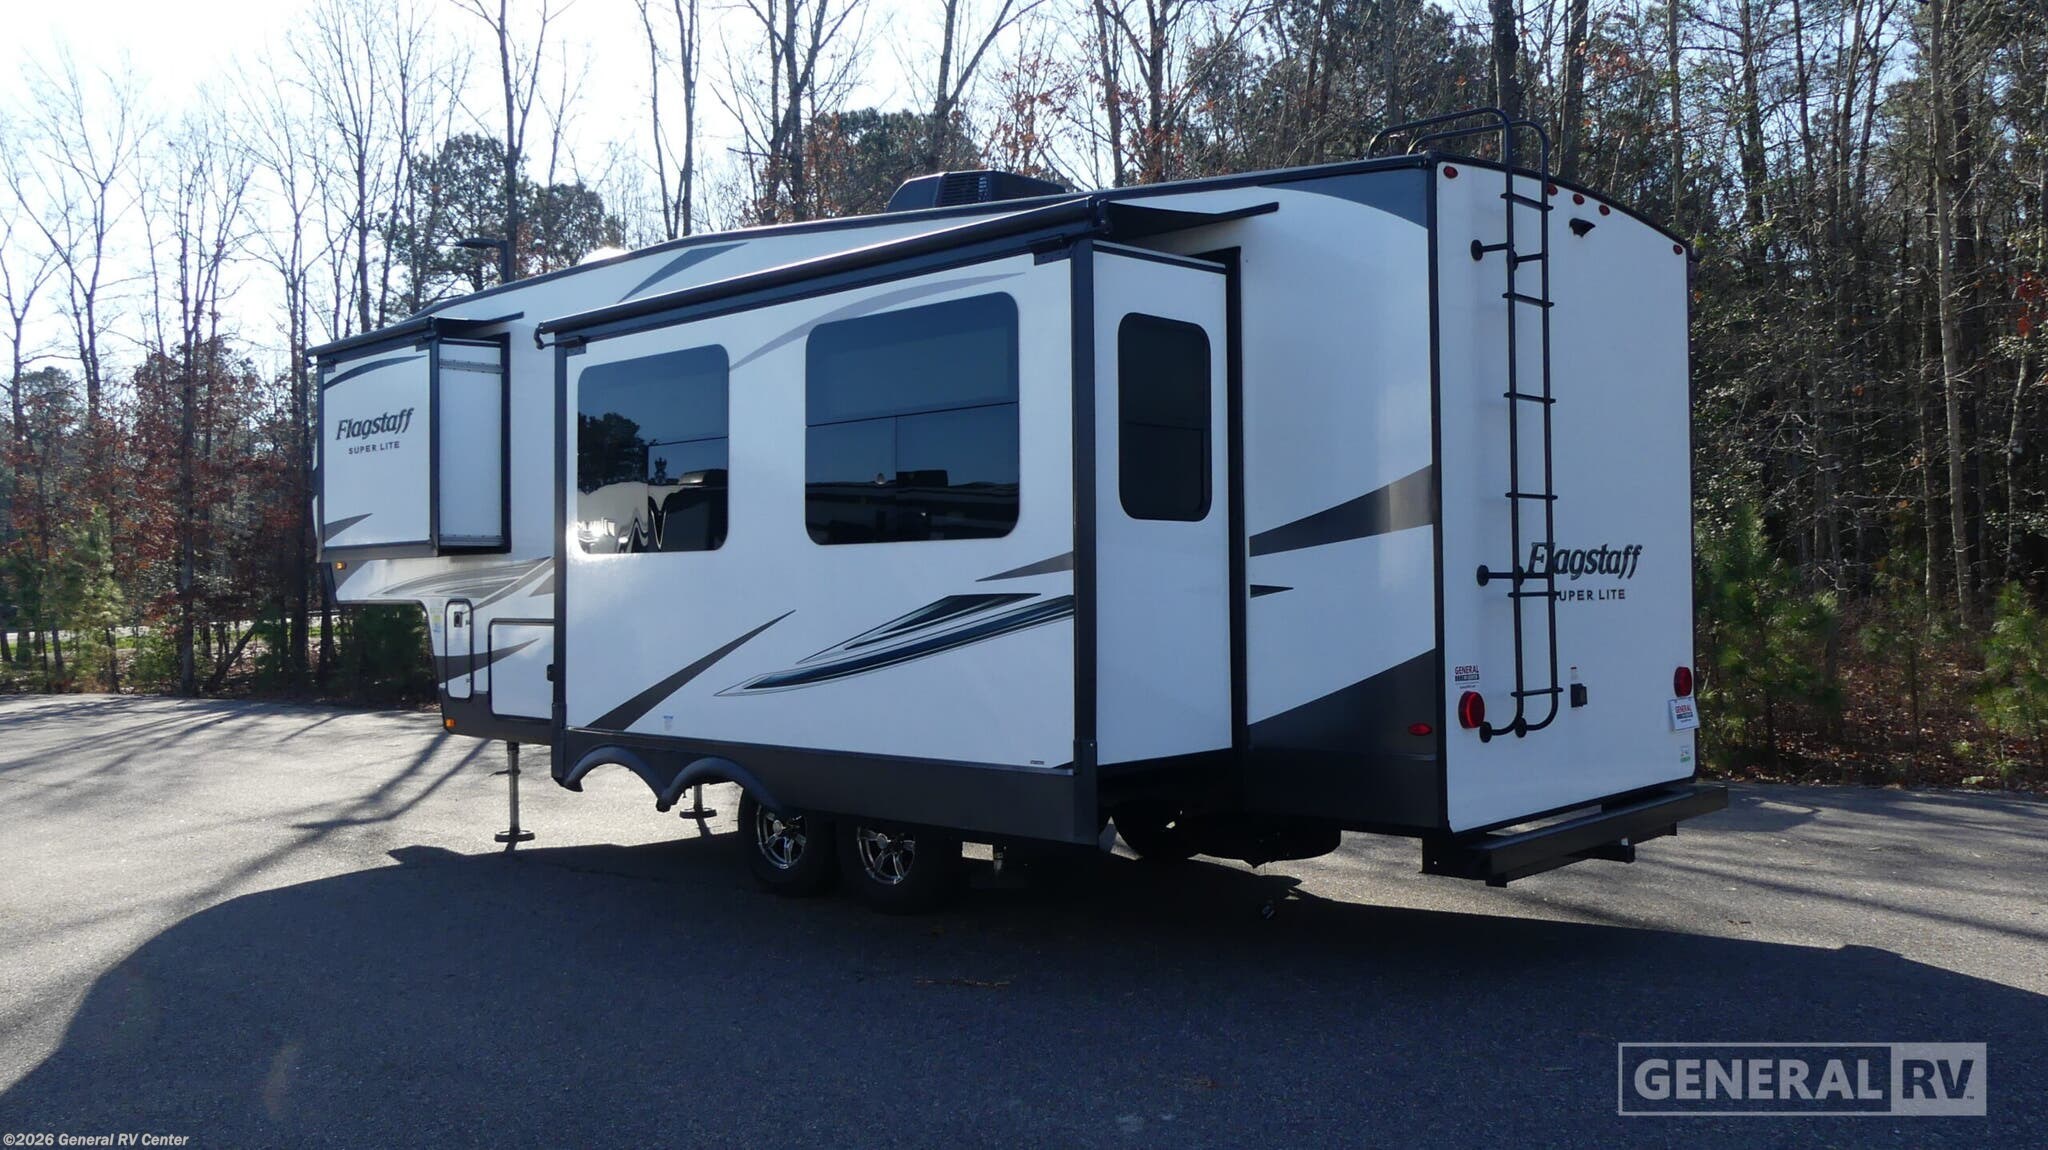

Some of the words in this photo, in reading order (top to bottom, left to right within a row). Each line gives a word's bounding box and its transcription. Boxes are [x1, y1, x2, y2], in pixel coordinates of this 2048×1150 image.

[335, 408, 414, 440] Flagstaff
[348, 445, 377, 455] SUPER
[380, 441, 400, 451] LITE
[1555, 590, 1593, 602] UPER
[1599, 589, 1625, 600] LITE
[1455, 665, 1479, 675] GENERAL
